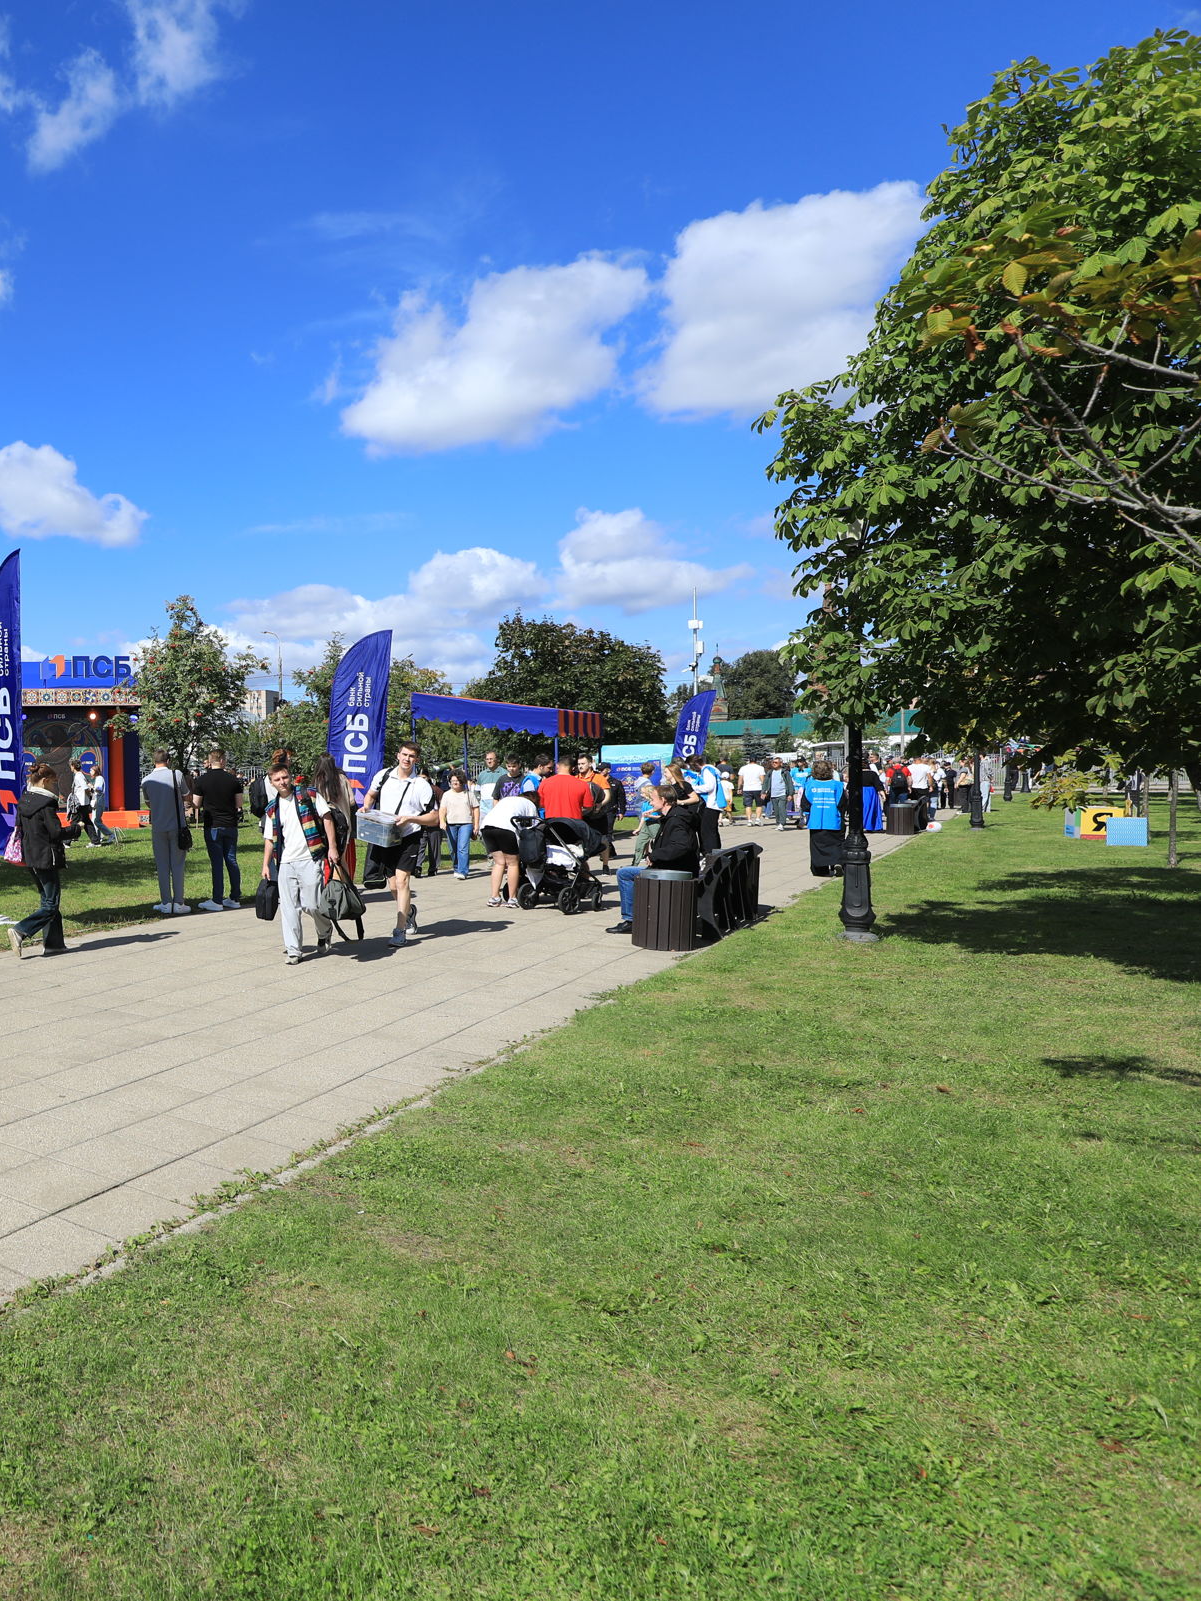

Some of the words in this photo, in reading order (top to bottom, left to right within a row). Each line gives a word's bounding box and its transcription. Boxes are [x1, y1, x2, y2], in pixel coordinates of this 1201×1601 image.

[71, 655, 132, 679] ПСБ
[356, 671, 364, 707] сильной
[342, 713, 368, 773] ПСБ
[681, 734, 697, 762] СБ
